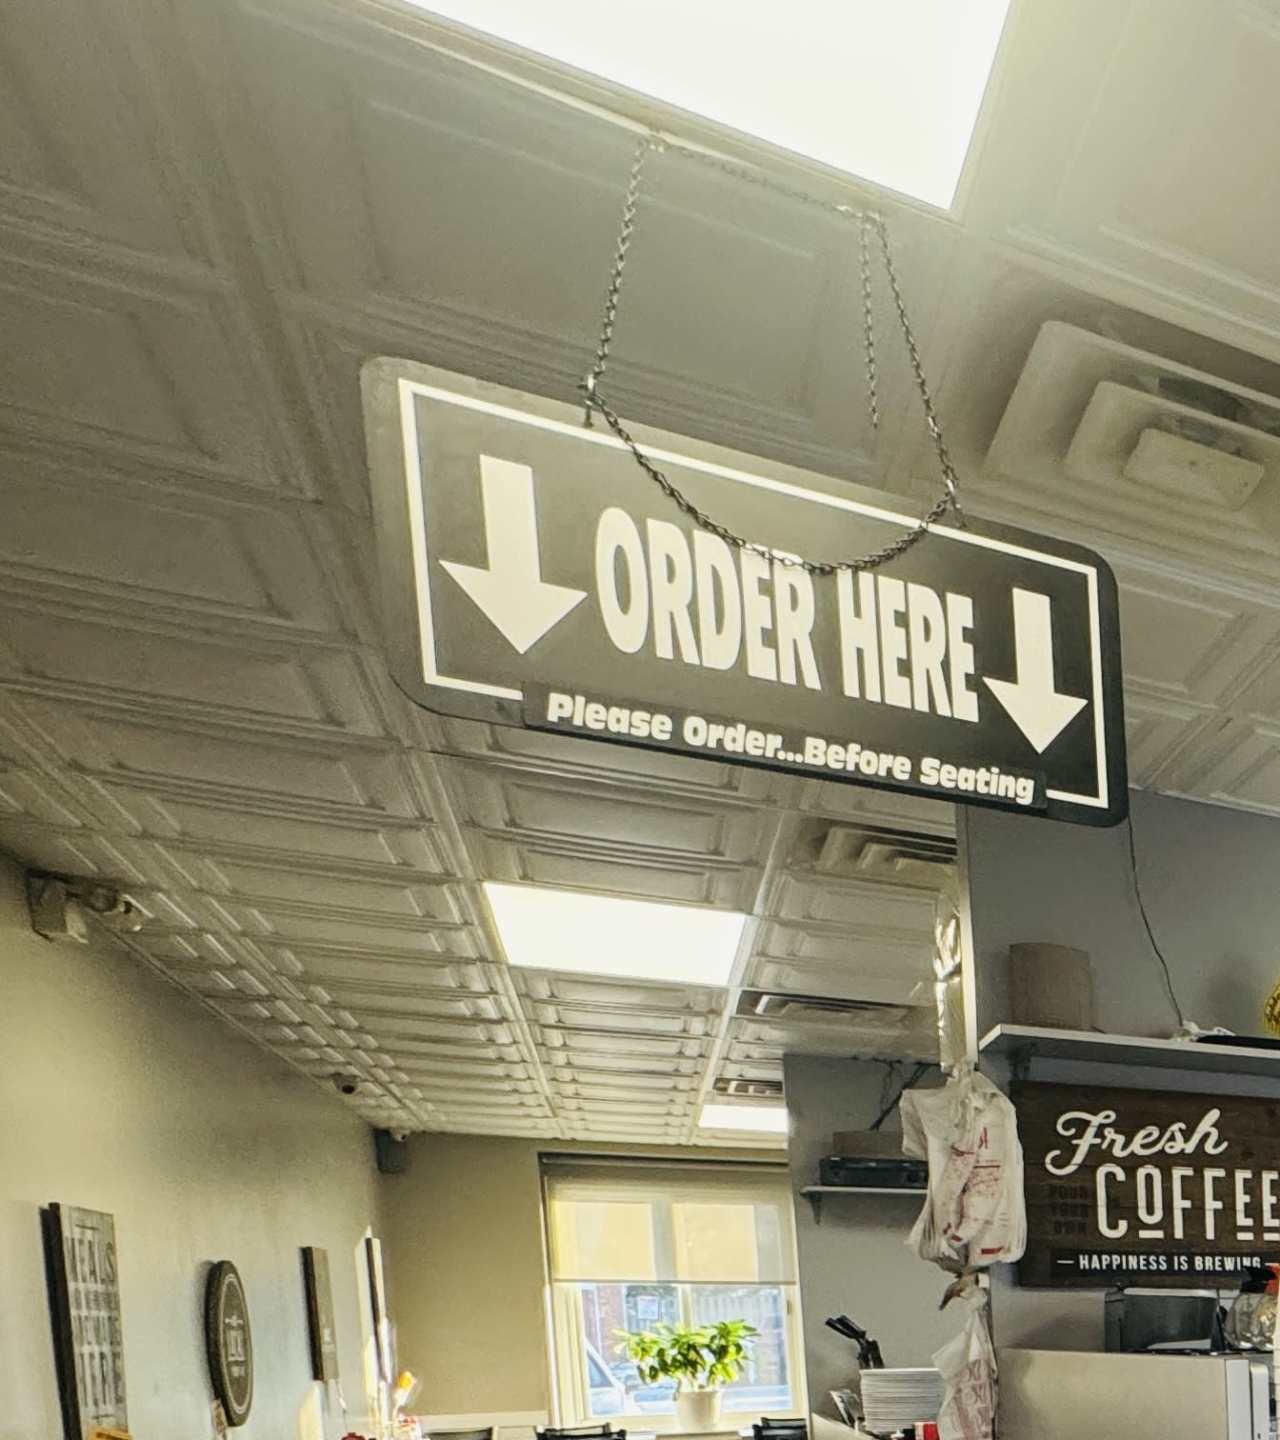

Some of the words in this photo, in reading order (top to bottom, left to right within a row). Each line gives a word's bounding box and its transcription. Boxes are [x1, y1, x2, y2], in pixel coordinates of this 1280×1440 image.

[596, 507, 822, 690] ORDER
[838, 567, 980, 723] HERE
[546, 692, 672, 741] Please
[920, 757, 1036, 804] Seating
[1044, 1107, 1228, 1176] Fresh
[1096, 1163, 1280, 1241] COFFEE
[1079, 1254, 1167, 1270] HAPPINESS
[1174, 1255, 1189, 1271] IS
[1195, 1256, 1262, 1272] BREWING
